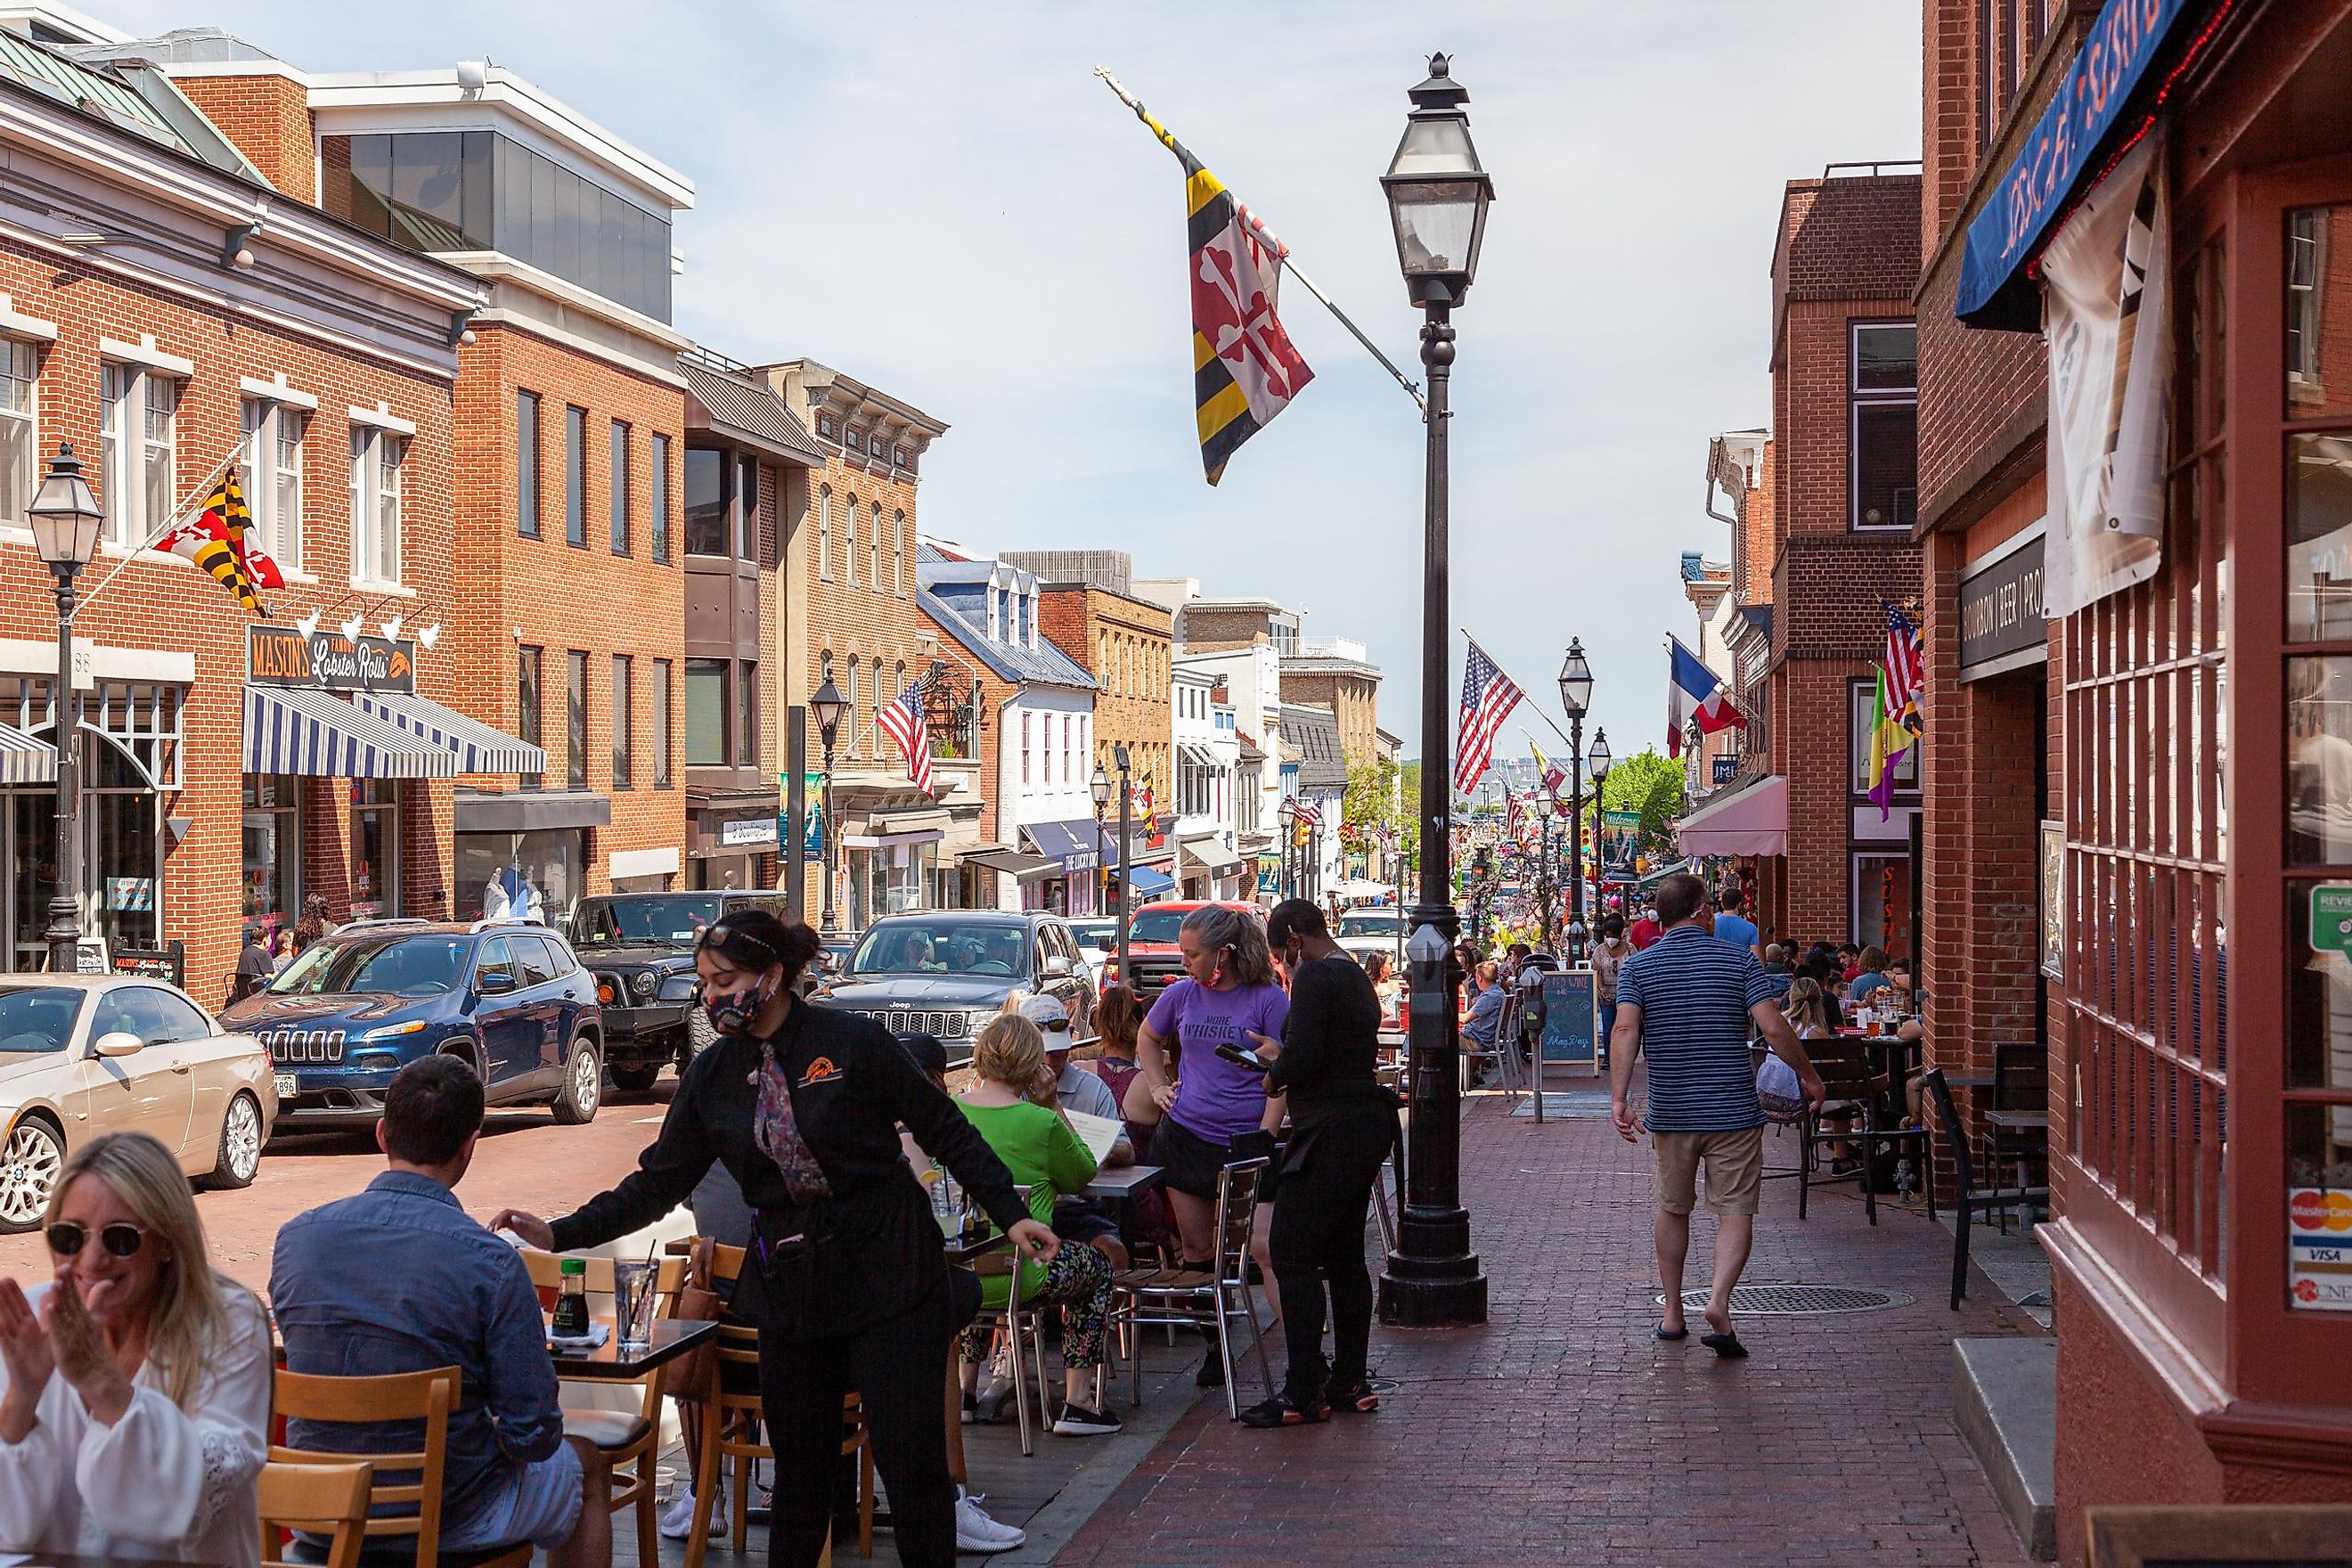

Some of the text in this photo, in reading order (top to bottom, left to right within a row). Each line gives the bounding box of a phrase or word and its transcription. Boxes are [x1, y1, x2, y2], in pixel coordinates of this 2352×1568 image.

[1964, 592, 1994, 642] BOURBON
[1999, 581, 2017, 628] BEER
[75, 652, 90, 674] 88
[311, 638, 357, 684] Lobster
[1606, 813, 1638, 825] Welcome
[1065, 854, 1074, 871] THE
[1074, 852, 1089, 870] LUCKY
[1881, 866, 1896, 954] SUSHI
[1569, 976, 1588, 989] WINE
[889, 1001, 911, 1009] Jeep
[1205, 1015, 1232, 1025] MORE
[1183, 1024, 1246, 1041] WHISKEY
[2311, 1249, 2340, 1262] VISA
